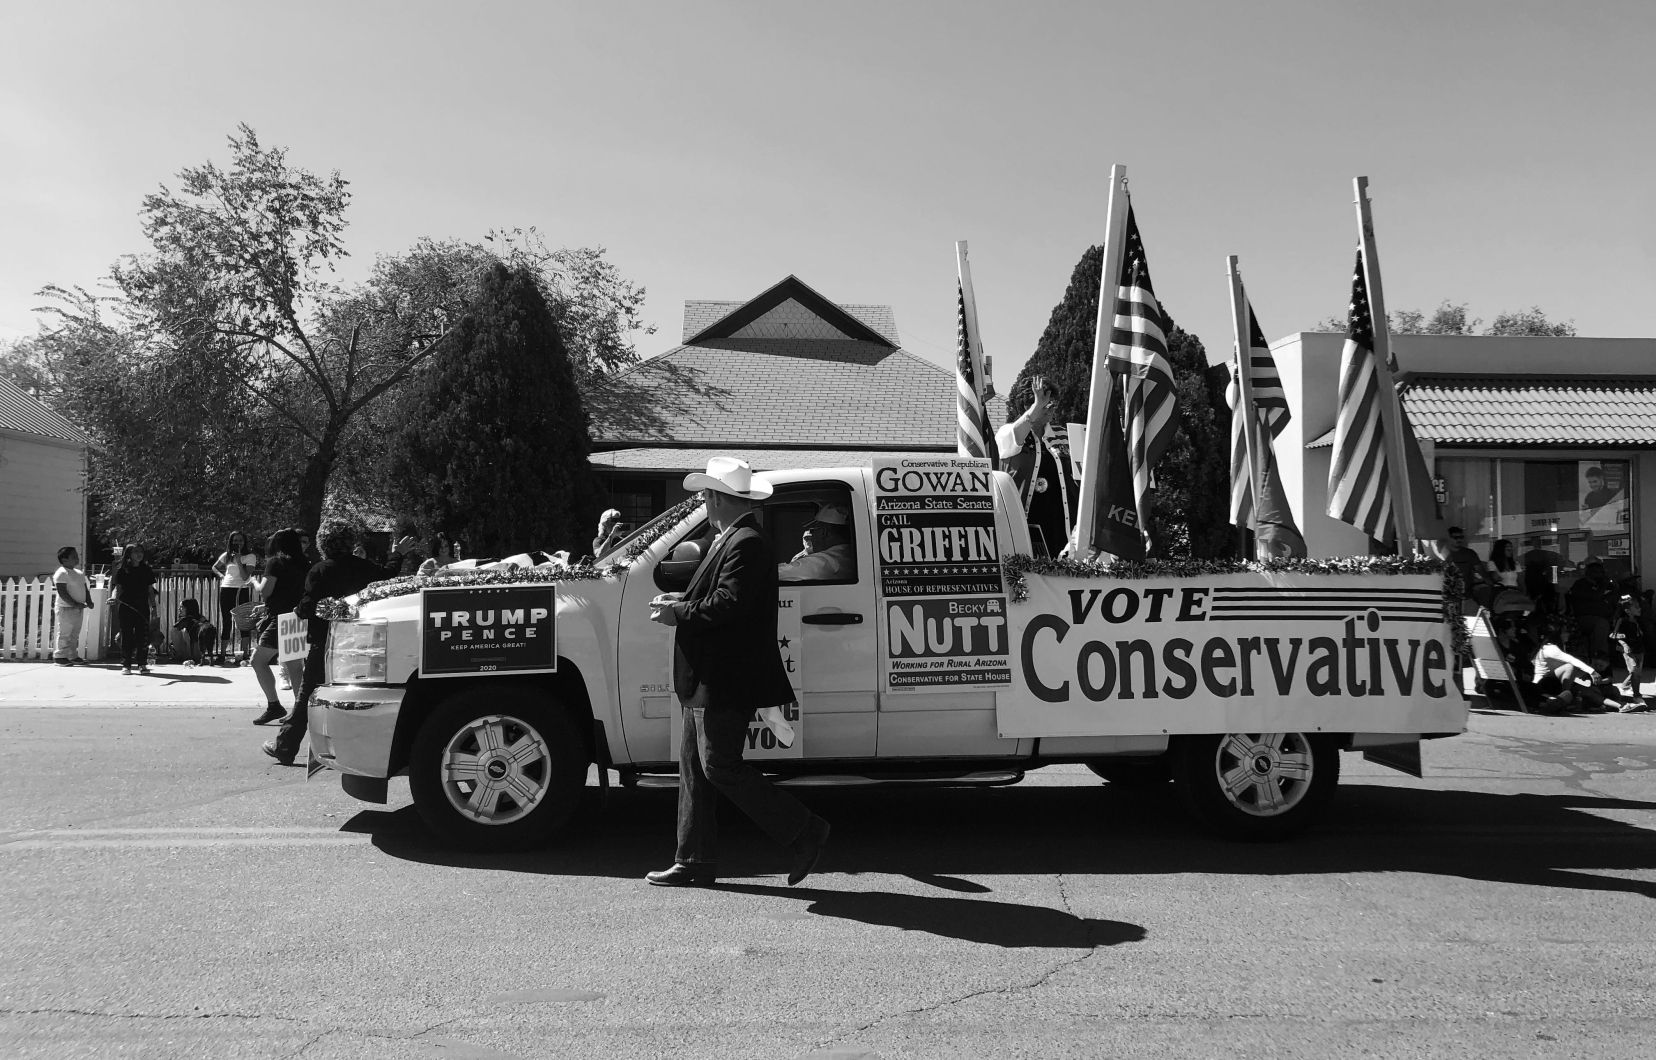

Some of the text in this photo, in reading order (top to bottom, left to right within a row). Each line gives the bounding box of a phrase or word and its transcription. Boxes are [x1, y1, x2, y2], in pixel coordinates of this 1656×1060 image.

[901, 459, 990, 469] Conservative Republican
[876, 467, 990, 493] GOWAN
[879, 498, 992, 510] Arizona State Senate
[881, 515, 911, 525] GAIL
[880, 526, 997, 563] GRIFFIN
[885, 584, 999, 594] HOUSE OF REPRESENTATIVES
[949, 602, 985, 614] BECKY
[1068, 587, 1210, 625] VOTE
[429, 607, 548, 628] TRUMP
[440, 627, 537, 641] PENCE
[889, 604, 1005, 656] NUTT
[1020, 609, 1448, 703] Conservative
[892, 658, 1007, 670] WORKING FOR RURAL ARIZONA
[890, 672, 1010, 684] CONSERVATIVE FOR STATE HOUSE
